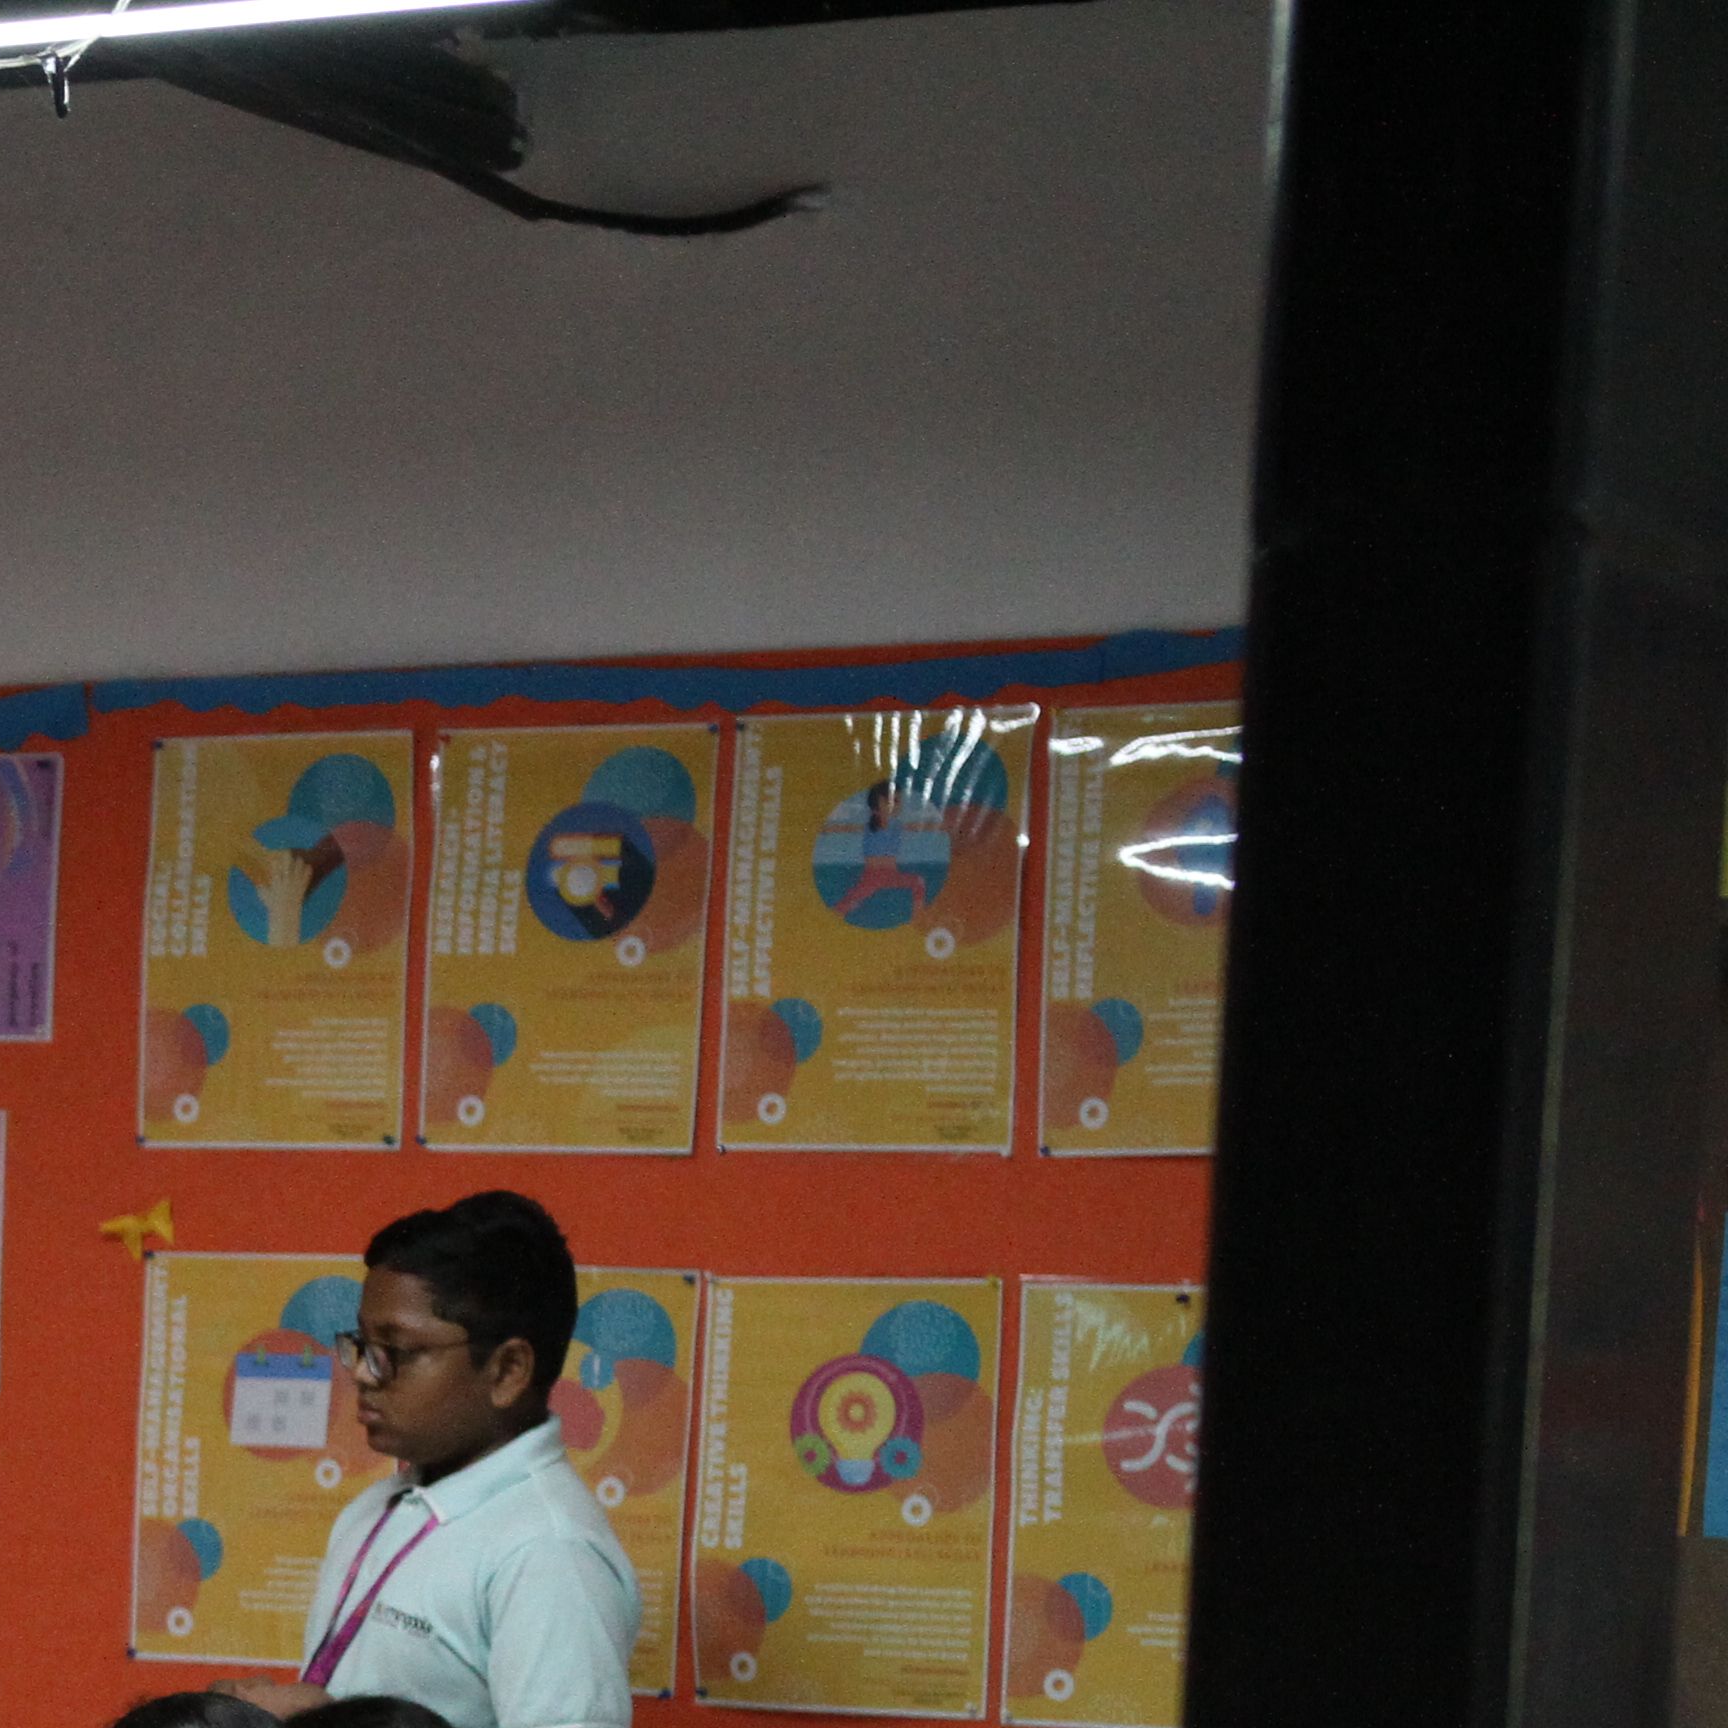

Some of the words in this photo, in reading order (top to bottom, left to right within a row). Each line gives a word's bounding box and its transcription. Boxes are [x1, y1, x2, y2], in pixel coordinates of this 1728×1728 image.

[486, 740, 509, 864] LITERACY
[191, 874, 212, 957] SKILLS
[477, 868, 501, 955] MEDIA
[499, 869, 521, 955] SKILLS
[710, 1288, 735, 1416] THINKING
[1051, 1291, 1074, 1381] SKILLS
[183, 1436, 201, 1518] SKILLS
[701, 1423, 725, 1548] CREATIVE
[1043, 1386, 1069, 1524] TRANSFER
[723, 1463, 747, 1549] SKILLS
